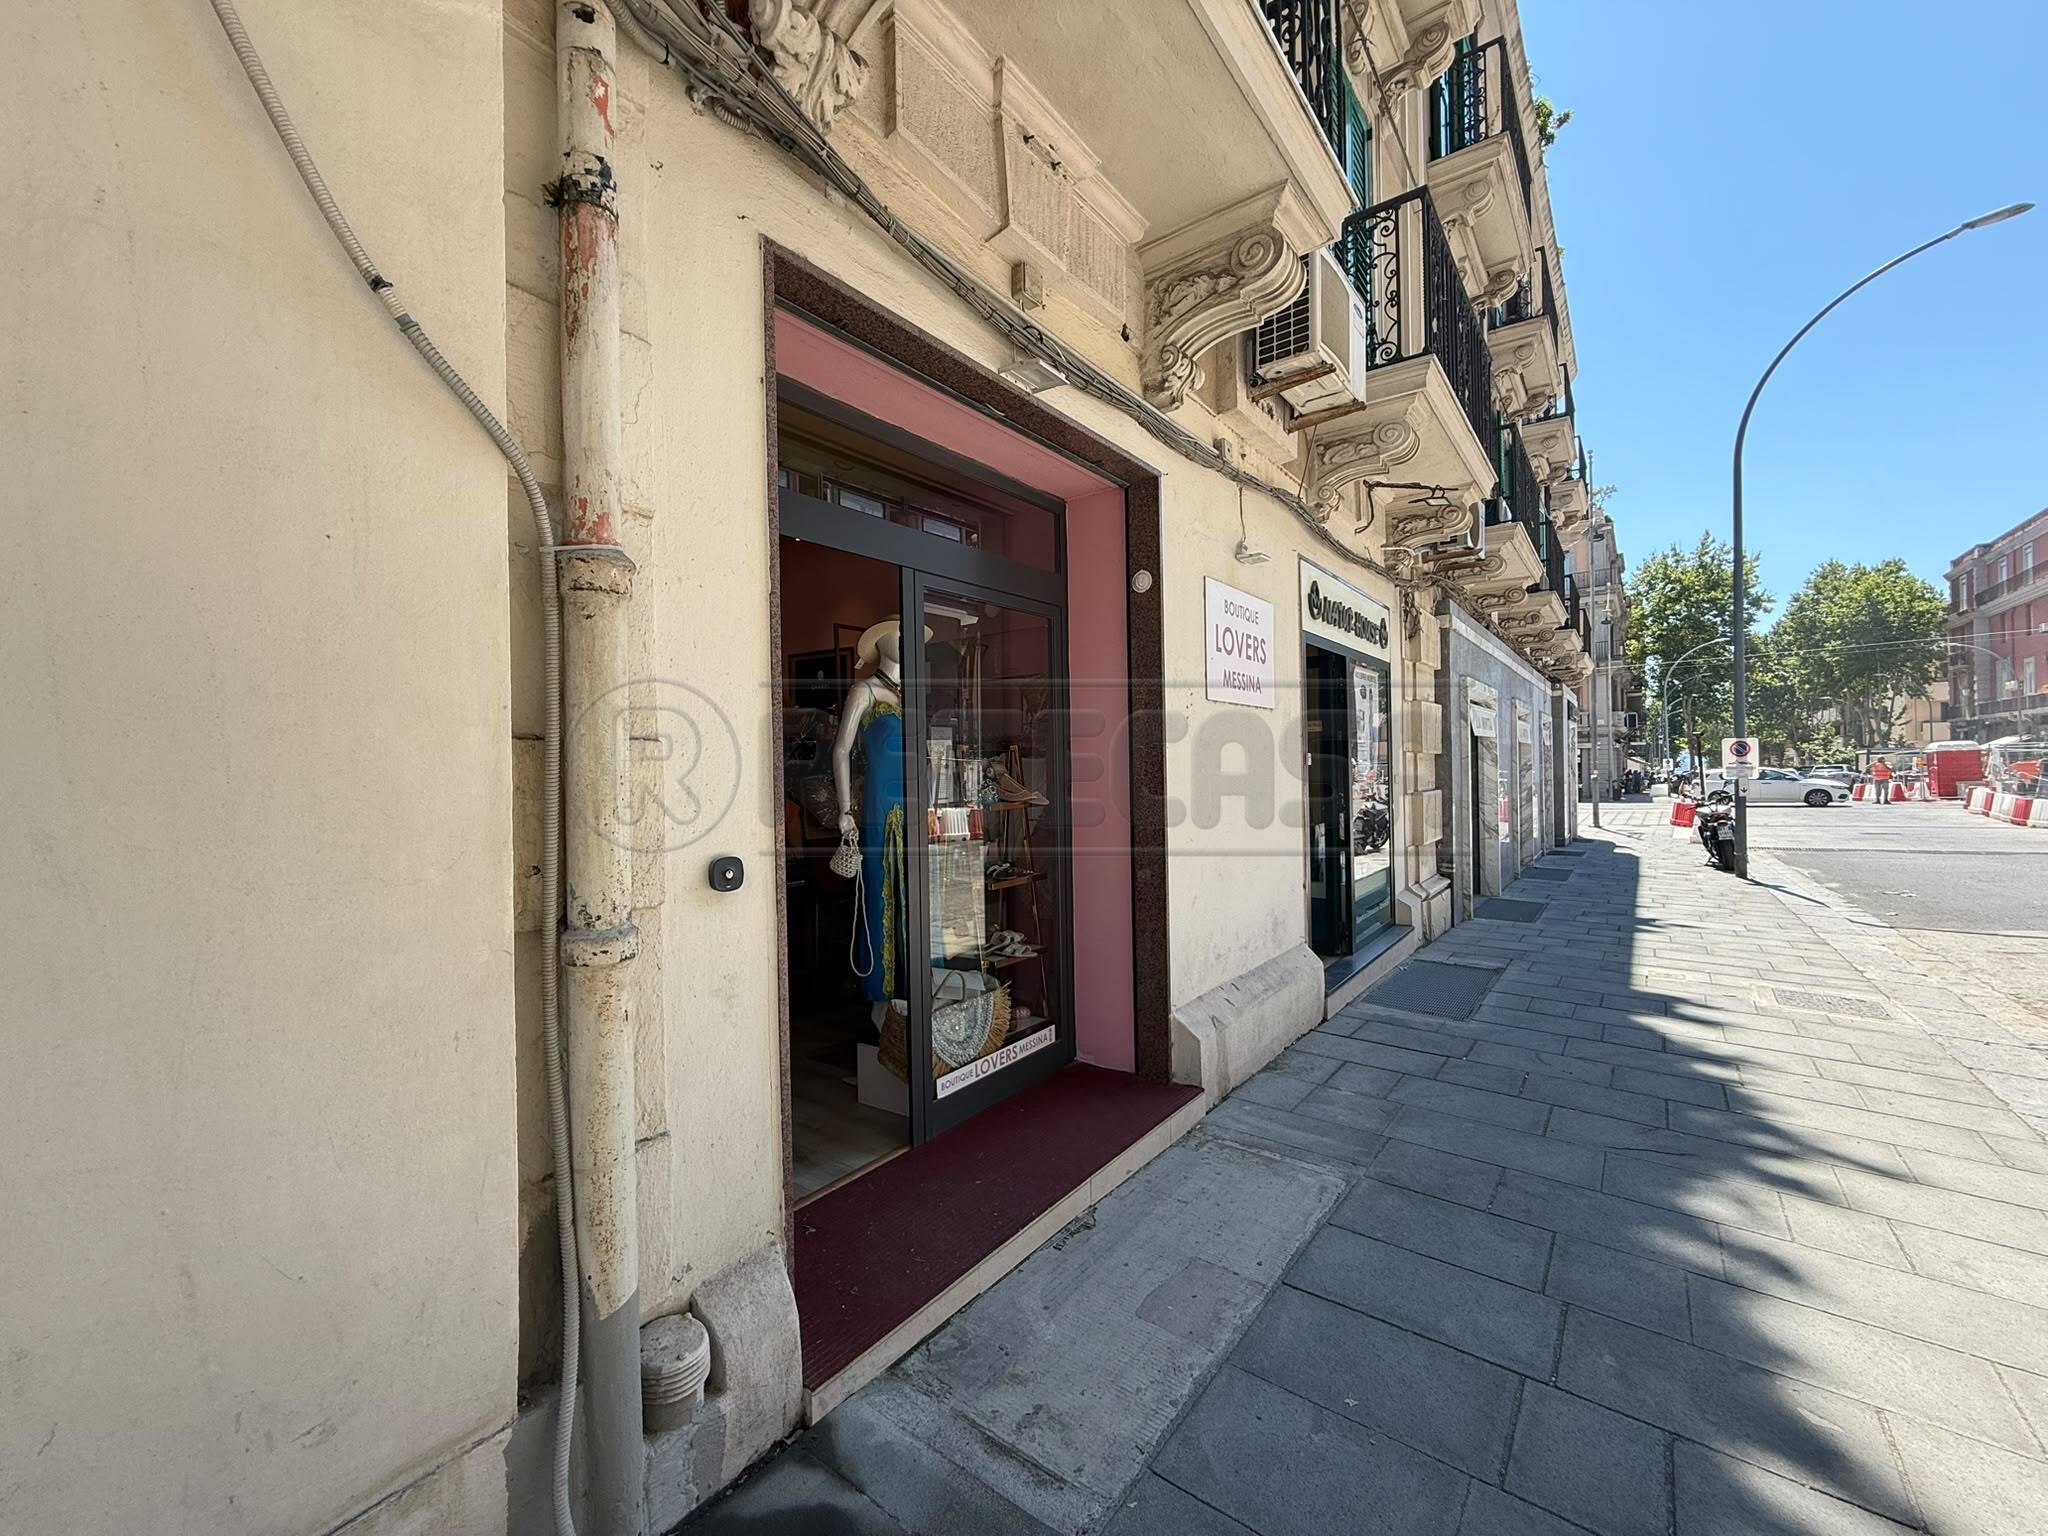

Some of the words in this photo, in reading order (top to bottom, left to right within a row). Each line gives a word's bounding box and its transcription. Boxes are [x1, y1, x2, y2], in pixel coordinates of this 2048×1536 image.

[1224, 599, 1259, 625] BOUTIQUE
[1215, 623, 1266, 665] LOVERS
[1223, 668, 1262, 694] MESSINA
[941, 1068, 975, 1092] BOUTIQUE
[974, 1045, 1018, 1079] LOVERS
[1018, 1032, 1048, 1055] MESSINA
